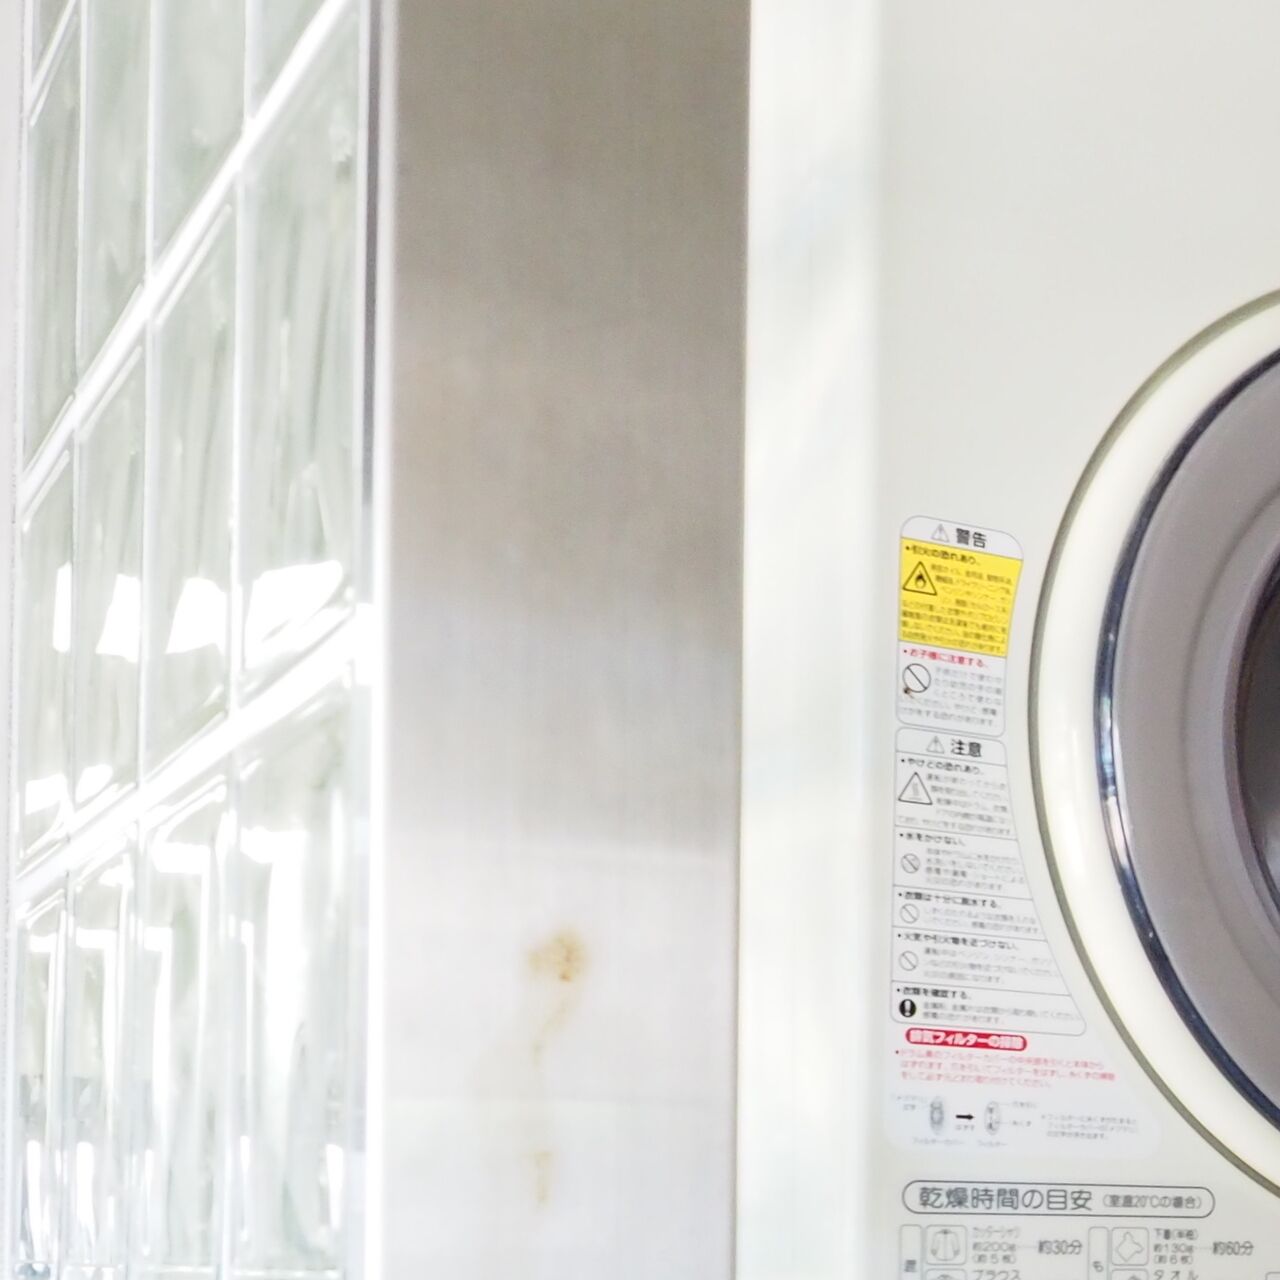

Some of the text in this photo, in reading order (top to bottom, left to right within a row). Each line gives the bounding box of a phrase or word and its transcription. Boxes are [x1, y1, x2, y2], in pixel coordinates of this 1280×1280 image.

[956, 528, 987, 549] 警告
[950, 739, 982, 758] 注意
[918, 1187, 1093, 1212] 乾燥時間の目安
[1038, 1240, 1083, 1255] 約30分
